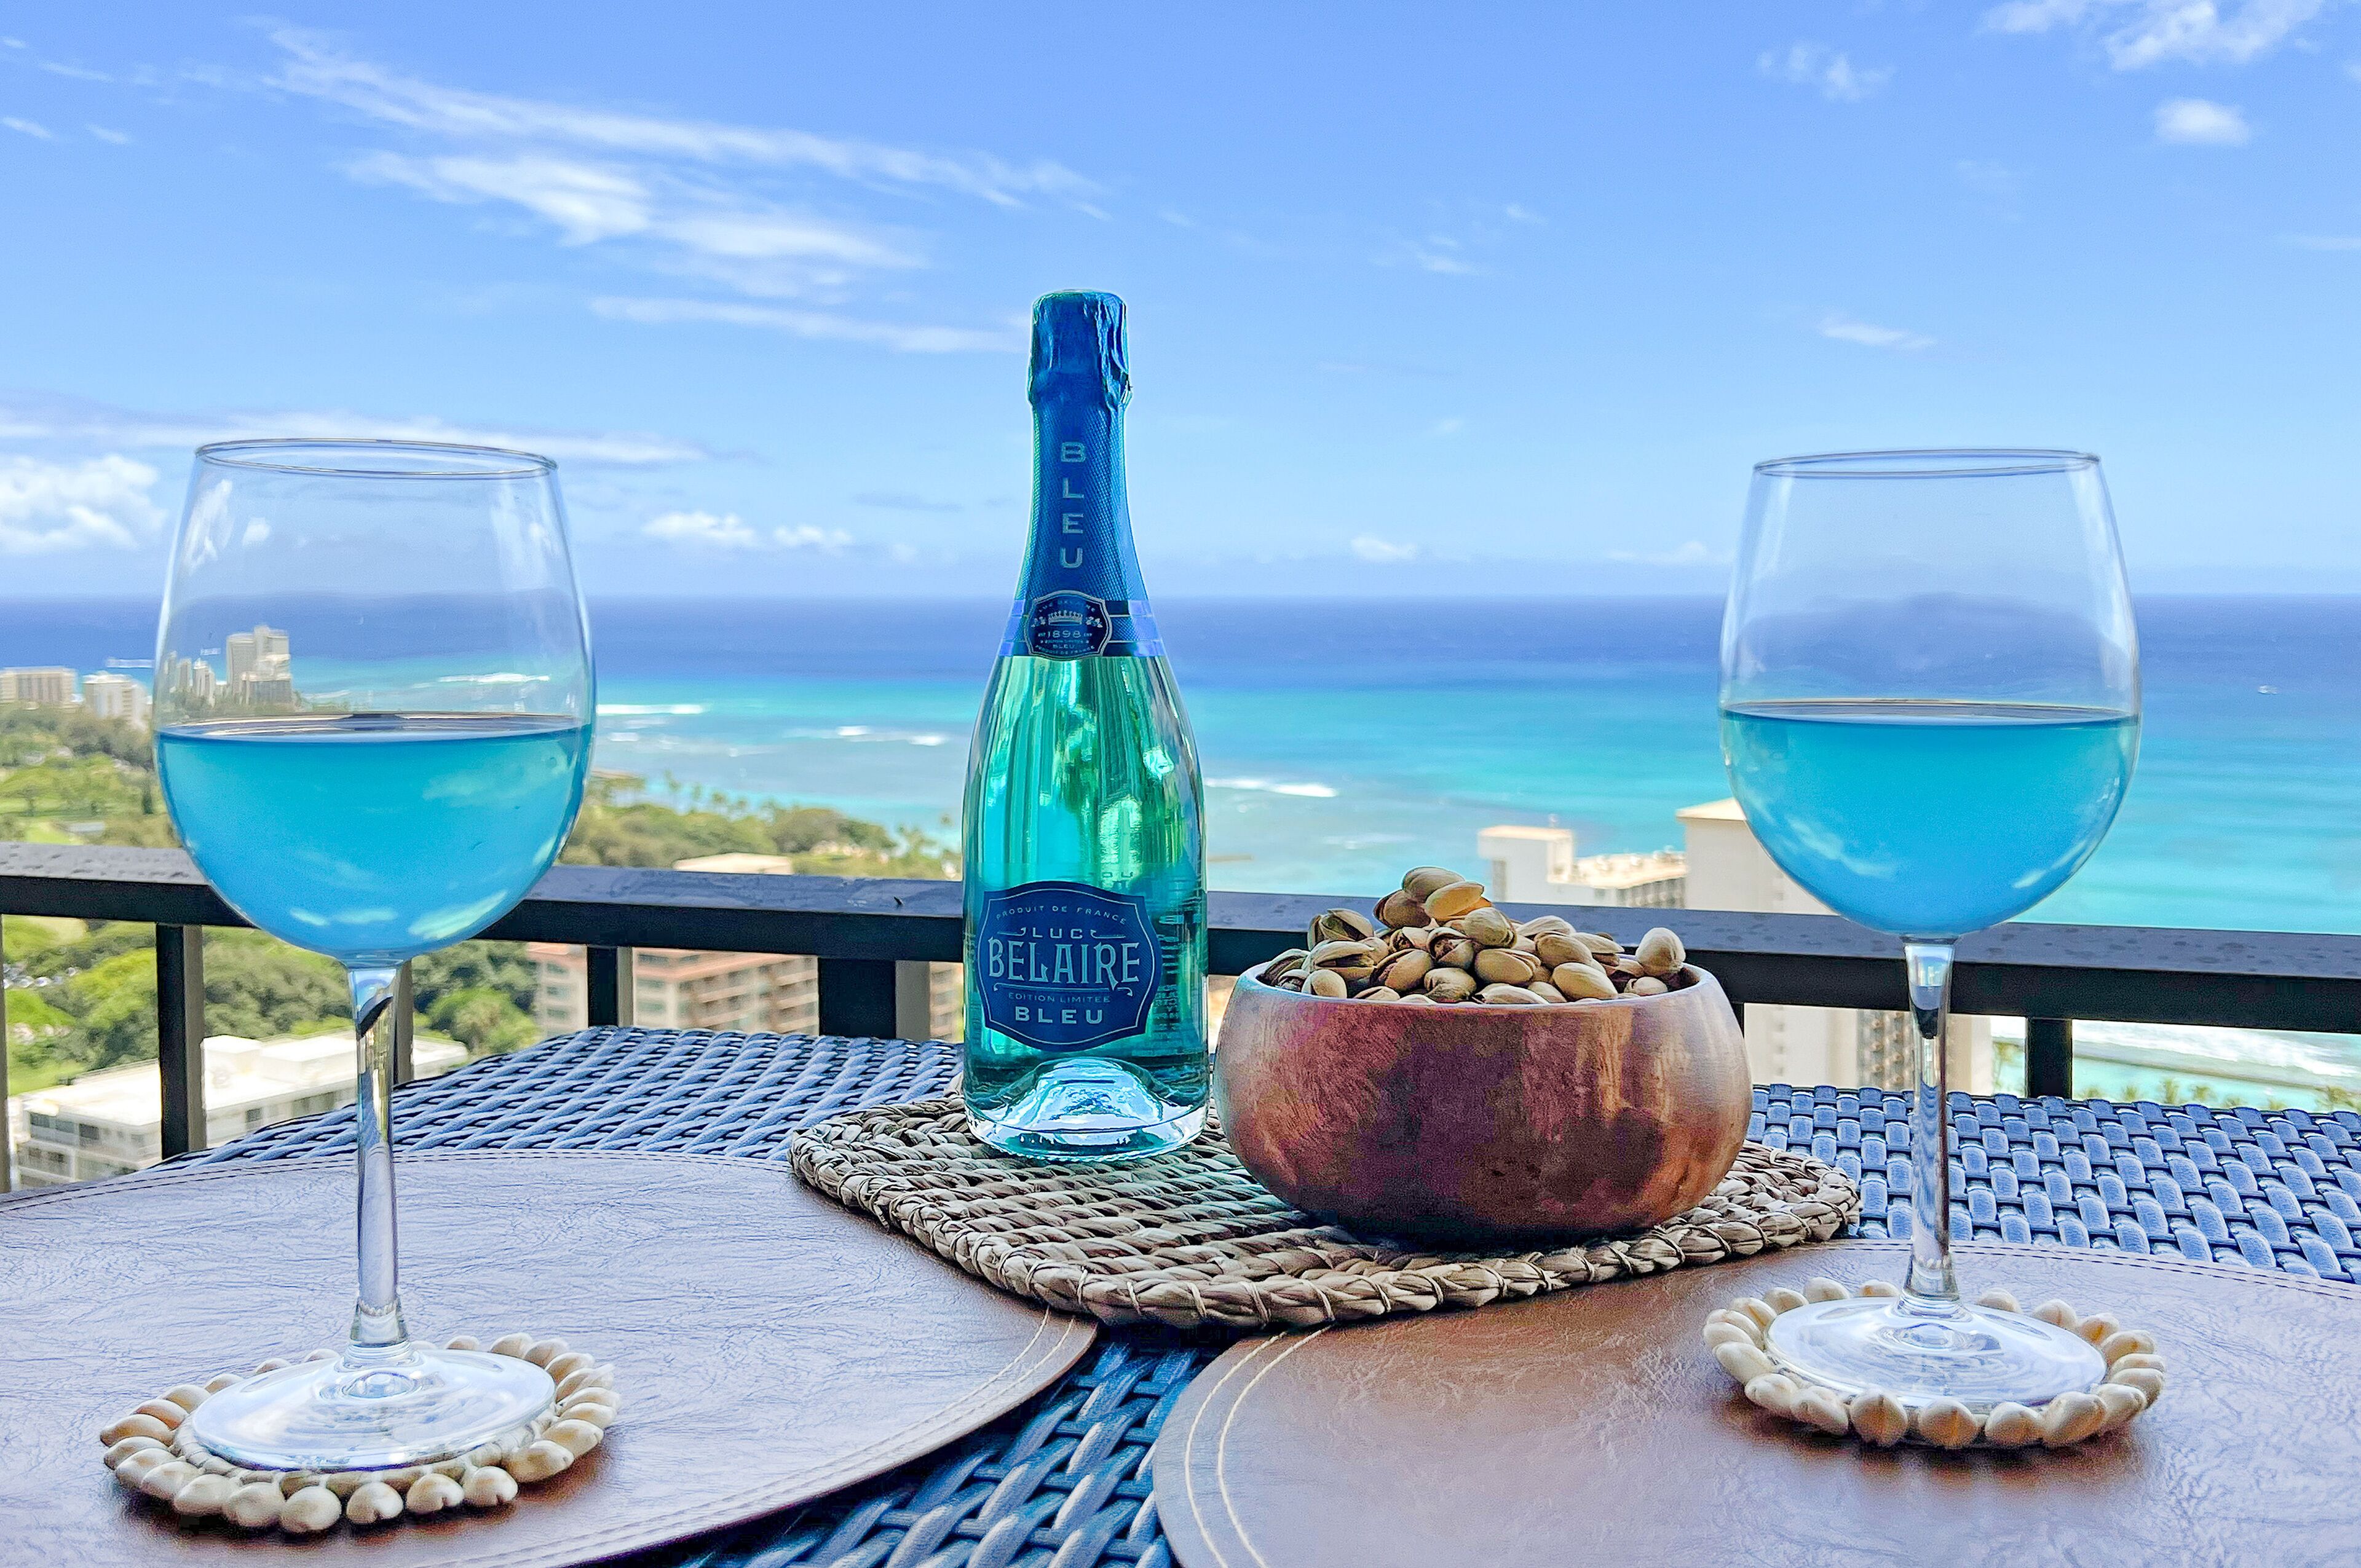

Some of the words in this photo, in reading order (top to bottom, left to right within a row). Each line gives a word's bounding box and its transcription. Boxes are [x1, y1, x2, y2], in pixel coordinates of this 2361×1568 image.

[1060, 441, 1086, 569] BLEU
[996, 905, 1044, 921] PRODUIT
[1077, 907, 1126, 925] FRANCE
[1032, 927, 1083, 939] LUC
[987, 936, 1140, 991] BELAIRE
[1015, 1006, 1103, 1025] BLEU
